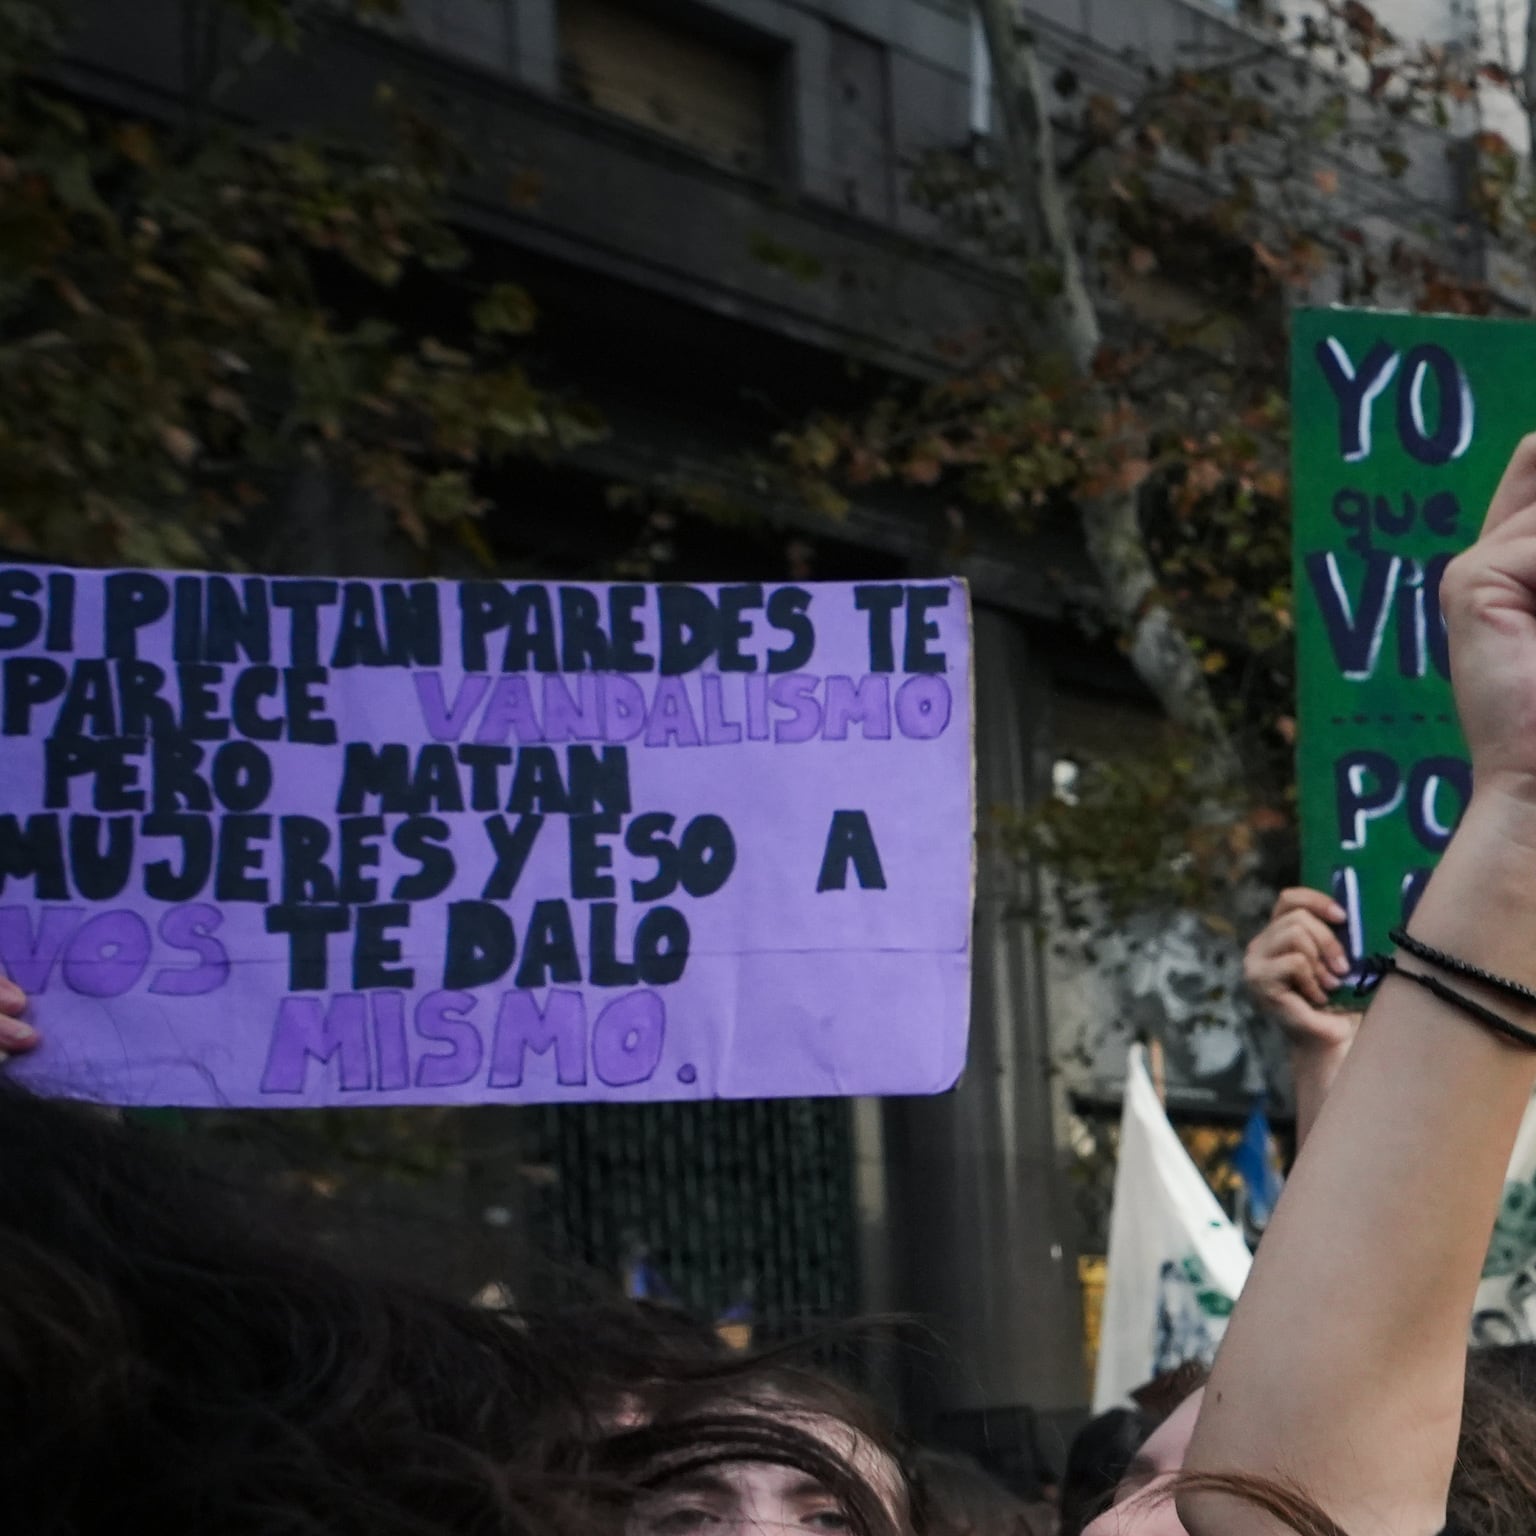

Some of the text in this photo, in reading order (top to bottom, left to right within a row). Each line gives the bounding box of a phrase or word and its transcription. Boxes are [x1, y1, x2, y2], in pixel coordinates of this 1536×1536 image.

[1315, 334, 1475, 465] YO
[1332, 488, 1461, 562] que
[0, 569, 951, 675] SI PINTAN PAREDES TE
[2, 657, 954, 748] PARECE VANDALISMO
[43, 737, 632, 815] PERO MATAN
[0, 809, 888, 903] MUJERES Y ESO A
[0, 903, 233, 998] VOS
[265, 902, 415, 992] TE
